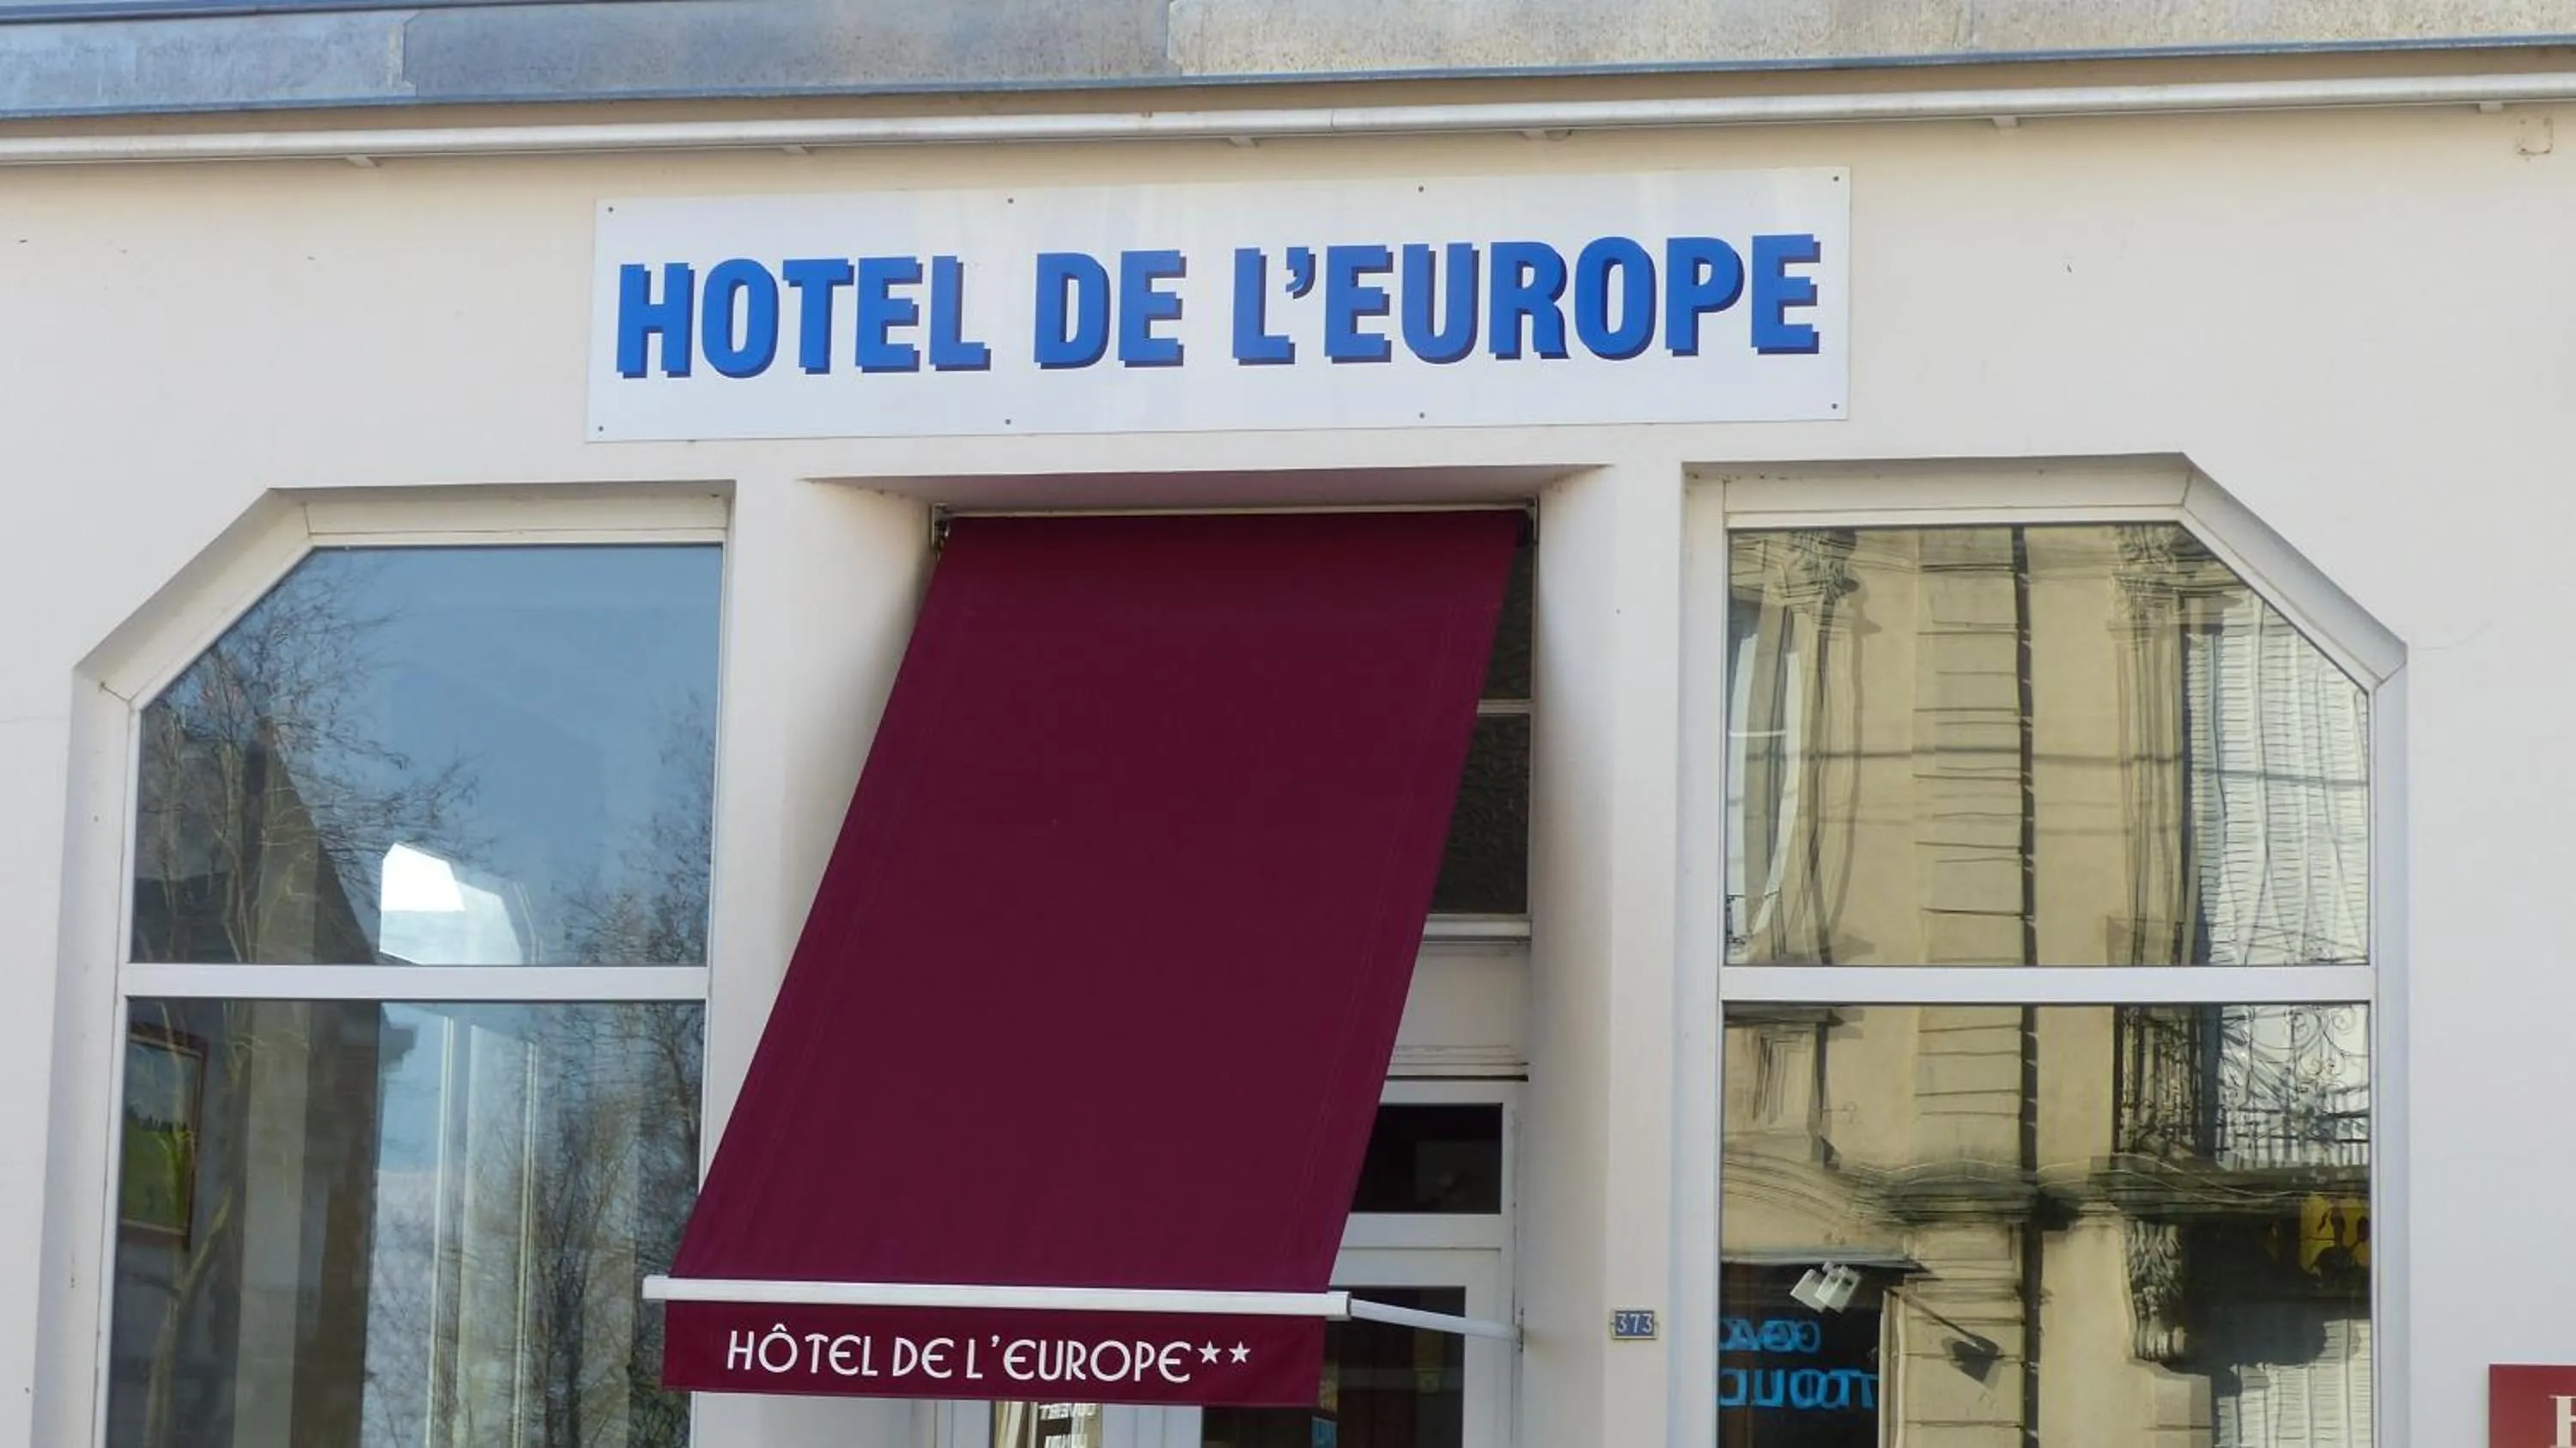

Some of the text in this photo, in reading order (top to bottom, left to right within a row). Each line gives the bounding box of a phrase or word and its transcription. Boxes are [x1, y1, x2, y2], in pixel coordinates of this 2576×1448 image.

[617, 233, 1821, 379] HOTEL DE L'EUROPE
[726, 1323, 878, 1377] HÔTEL
[892, 1337, 954, 1378] DE
[1616, 1313, 1653, 1334] 373
